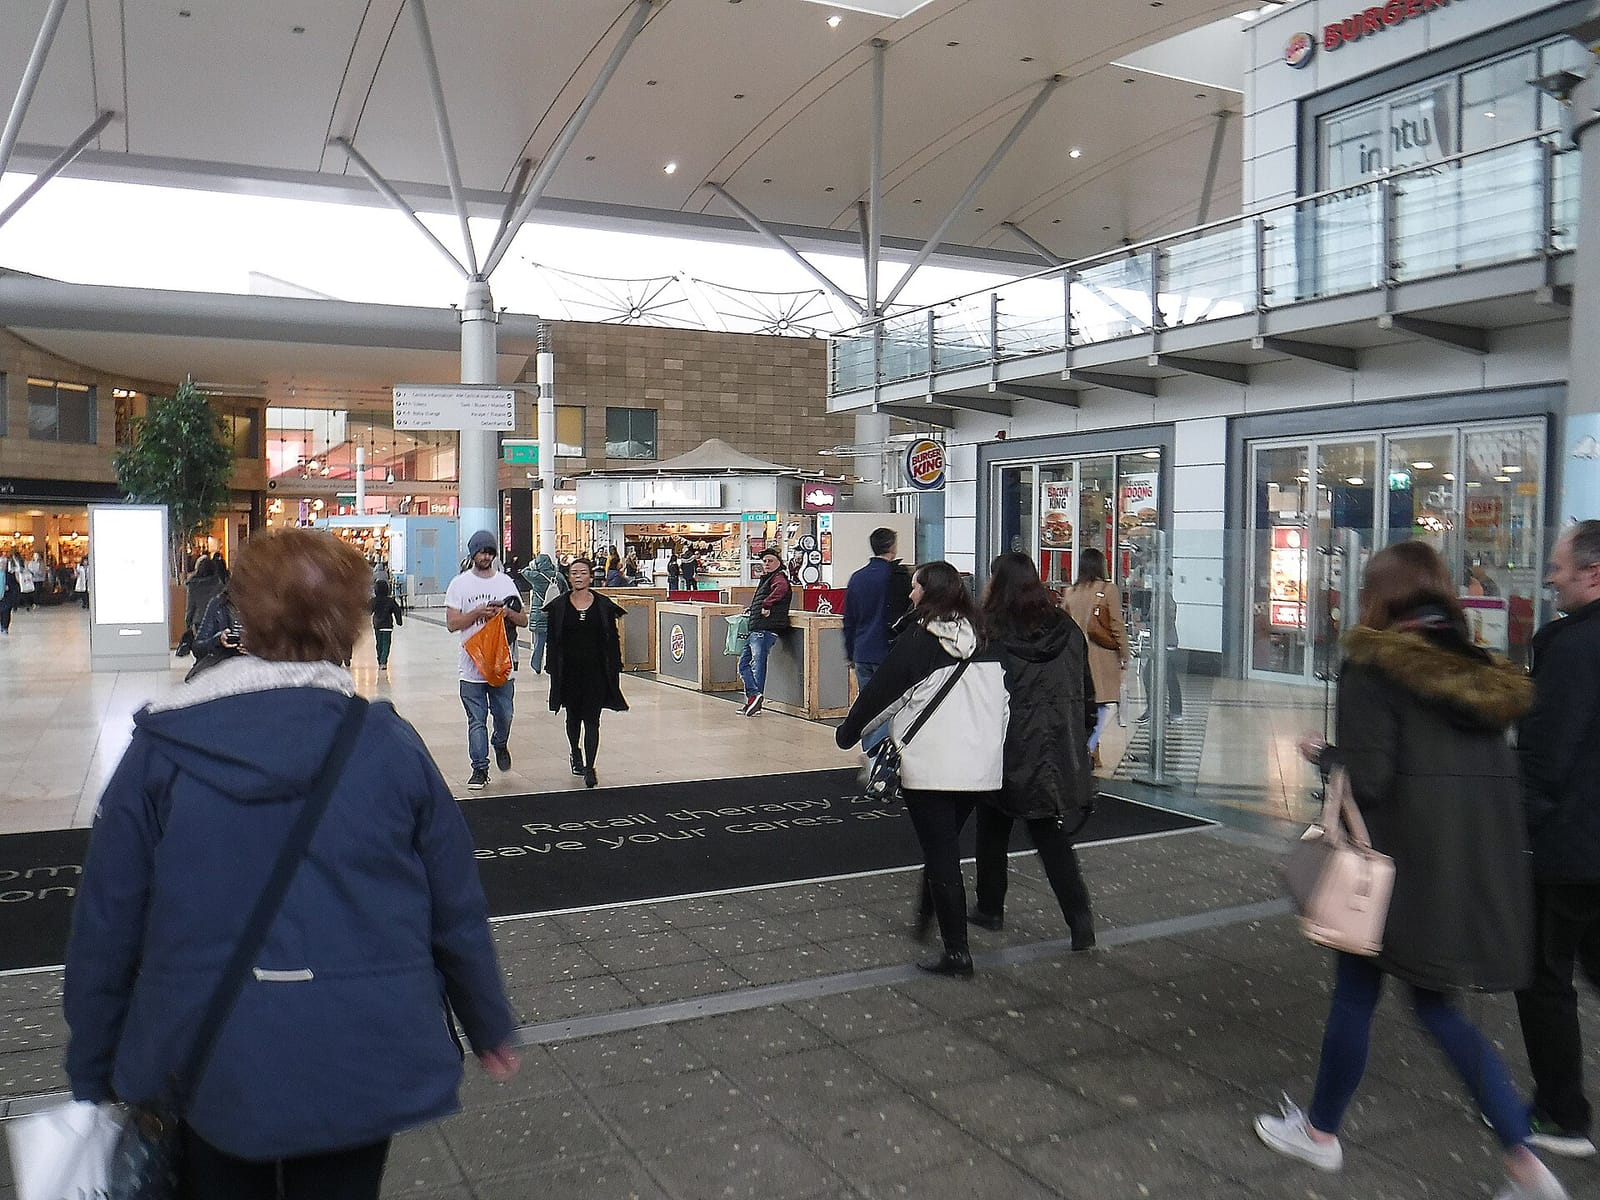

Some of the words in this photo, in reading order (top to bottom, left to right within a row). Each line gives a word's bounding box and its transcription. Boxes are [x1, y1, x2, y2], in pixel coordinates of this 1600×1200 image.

[912, 448, 942, 466] BURGER
[913, 457, 943, 478] KING
[1047, 486, 1069, 498] BACON
[1049, 498, 1067, 509] KING
[671, 640, 684, 652] KING
[521, 813, 657, 835] Retail
[665, 798, 832, 821] therapy
[597, 826, 707, 850] your
[724, 815, 844, 834] cares
